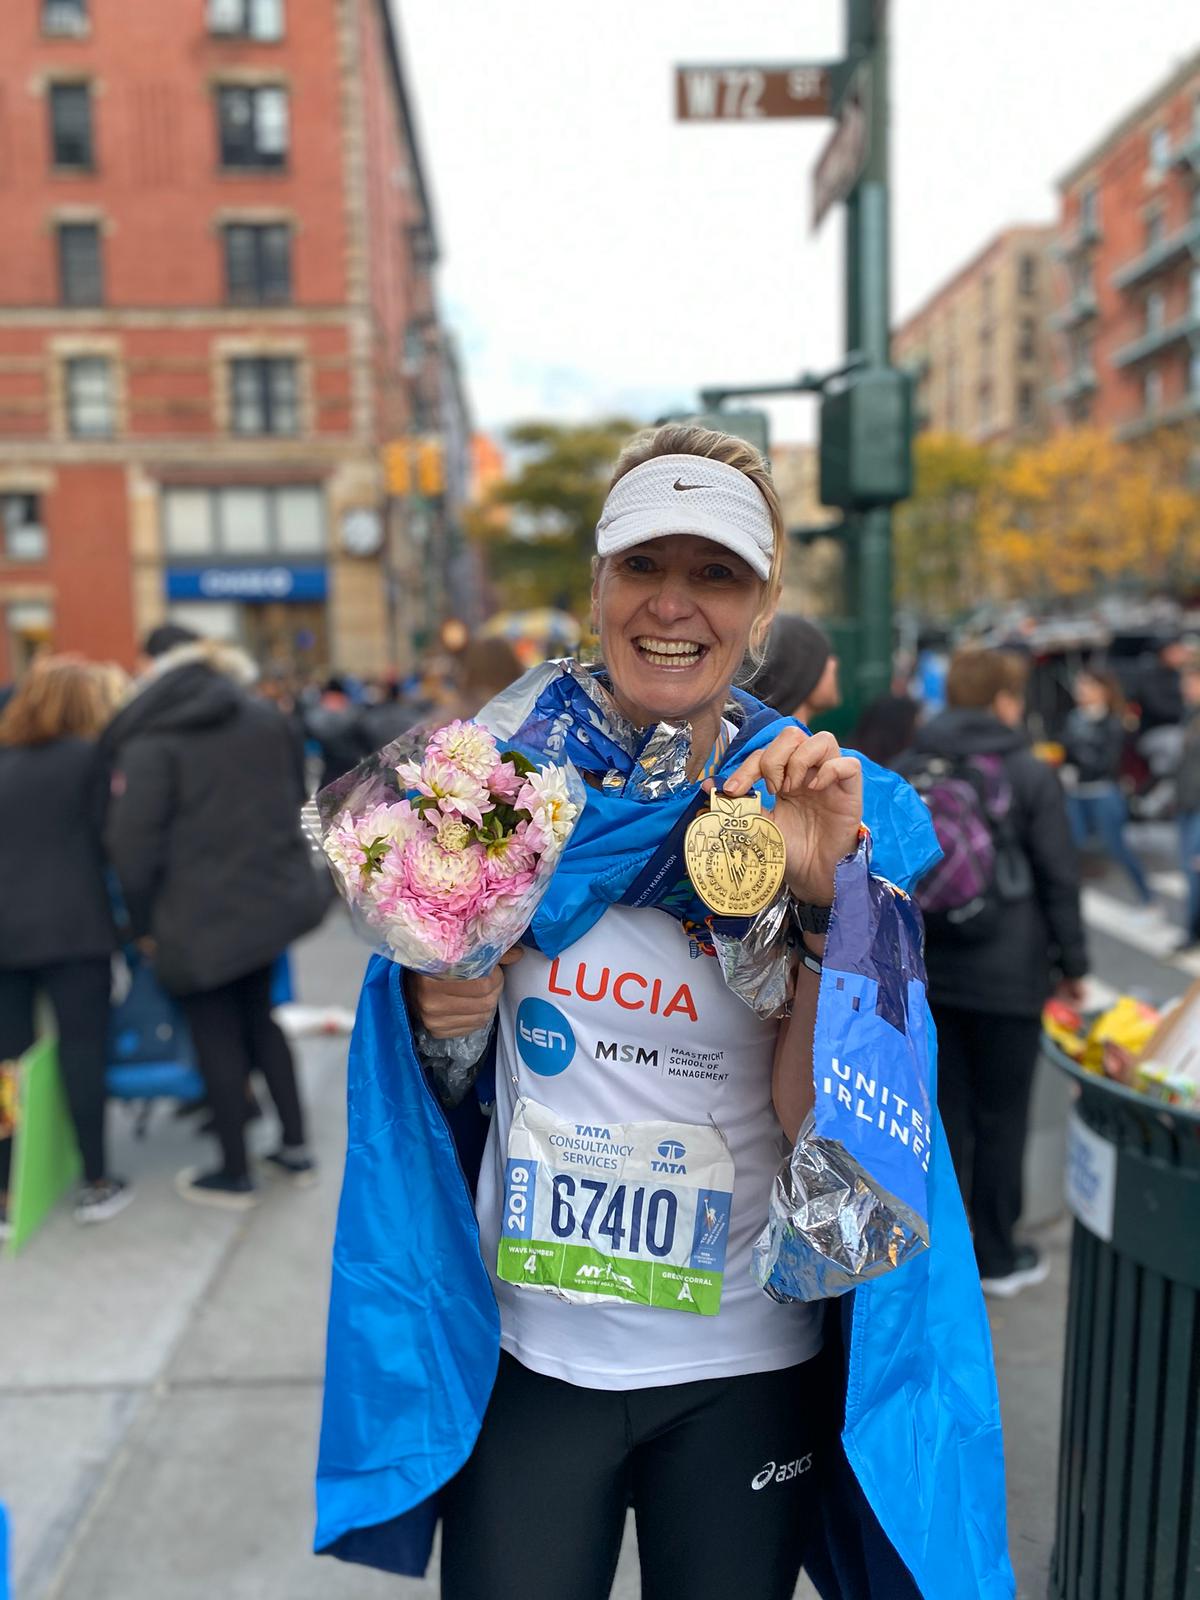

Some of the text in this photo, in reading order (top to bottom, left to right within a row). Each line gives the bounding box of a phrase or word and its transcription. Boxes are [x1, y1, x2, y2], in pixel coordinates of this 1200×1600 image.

[685, 68, 821, 118] W 72 ST
[724, 818, 749, 828] 2019
[731, 834, 752, 846] TCS
[752, 844, 767, 866] NEW
[640, 888, 652, 900] CITY
[649, 854, 678, 889] MARATHON
[705, 843, 728, 898] MARATHON
[752, 867, 767, 894] YORK
[548, 956, 698, 1022] LUCIA
[519, 1019, 566, 1052] ten
[594, 1040, 659, 1067] MSM
[669, 1057, 719, 1071] SCHOOL OF
[671, 1048, 724, 1061] MAASTRICHT
[668, 1068, 729, 1081] MANAGEMENT
[574, 1124, 611, 1140] TATA
[549, 1134, 634, 1157] CONSULTANCY
[562, 1151, 618, 1170] SERVICES
[651, 1160, 687, 1175] TATA
[508, 1167, 529, 1232] 2019
[550, 1174, 678, 1257] 67410
[508, 1246, 554, 1257] WAVE NUMBER
[523, 1254, 537, 1274] 4
[684, 1276, 713, 1286] CORRAL
[677, 1282, 694, 1303] A
